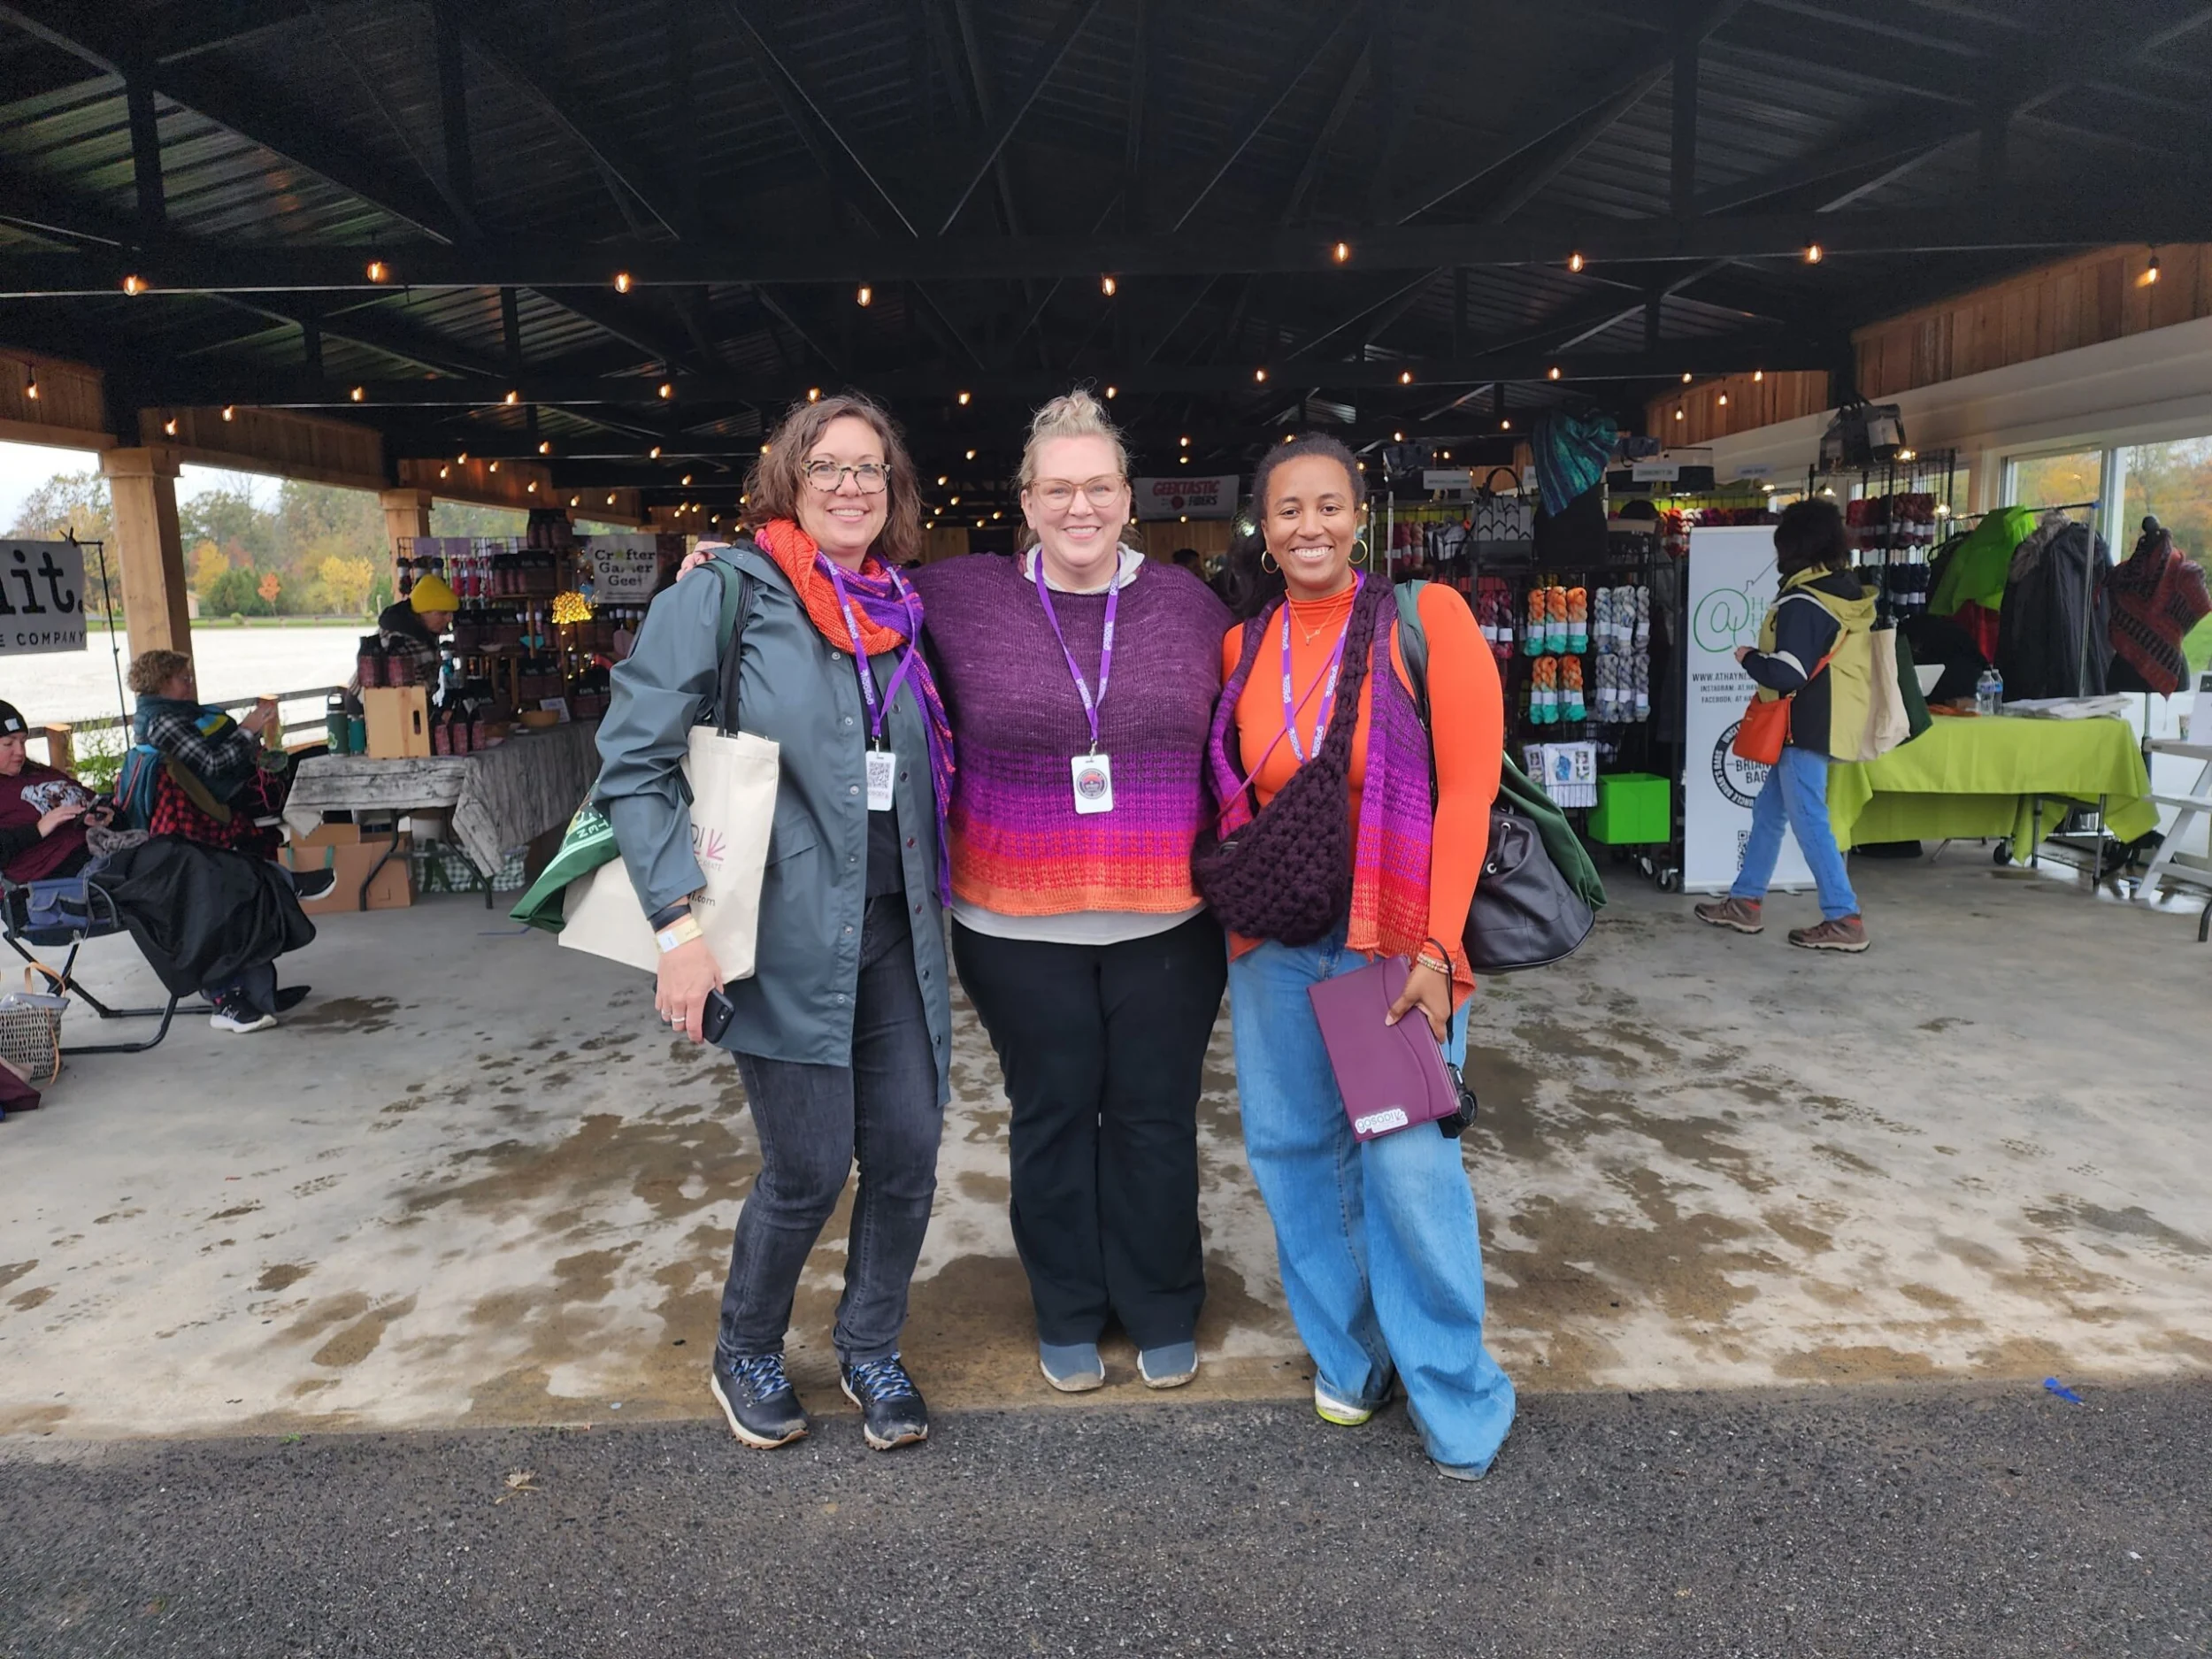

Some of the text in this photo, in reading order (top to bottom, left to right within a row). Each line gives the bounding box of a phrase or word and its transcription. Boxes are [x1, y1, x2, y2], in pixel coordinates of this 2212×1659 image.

[1153, 480, 1221, 496] GEEKTASTIC
[595, 549, 656, 561] Crfter
[16, 630, 85, 646] COMPANY
